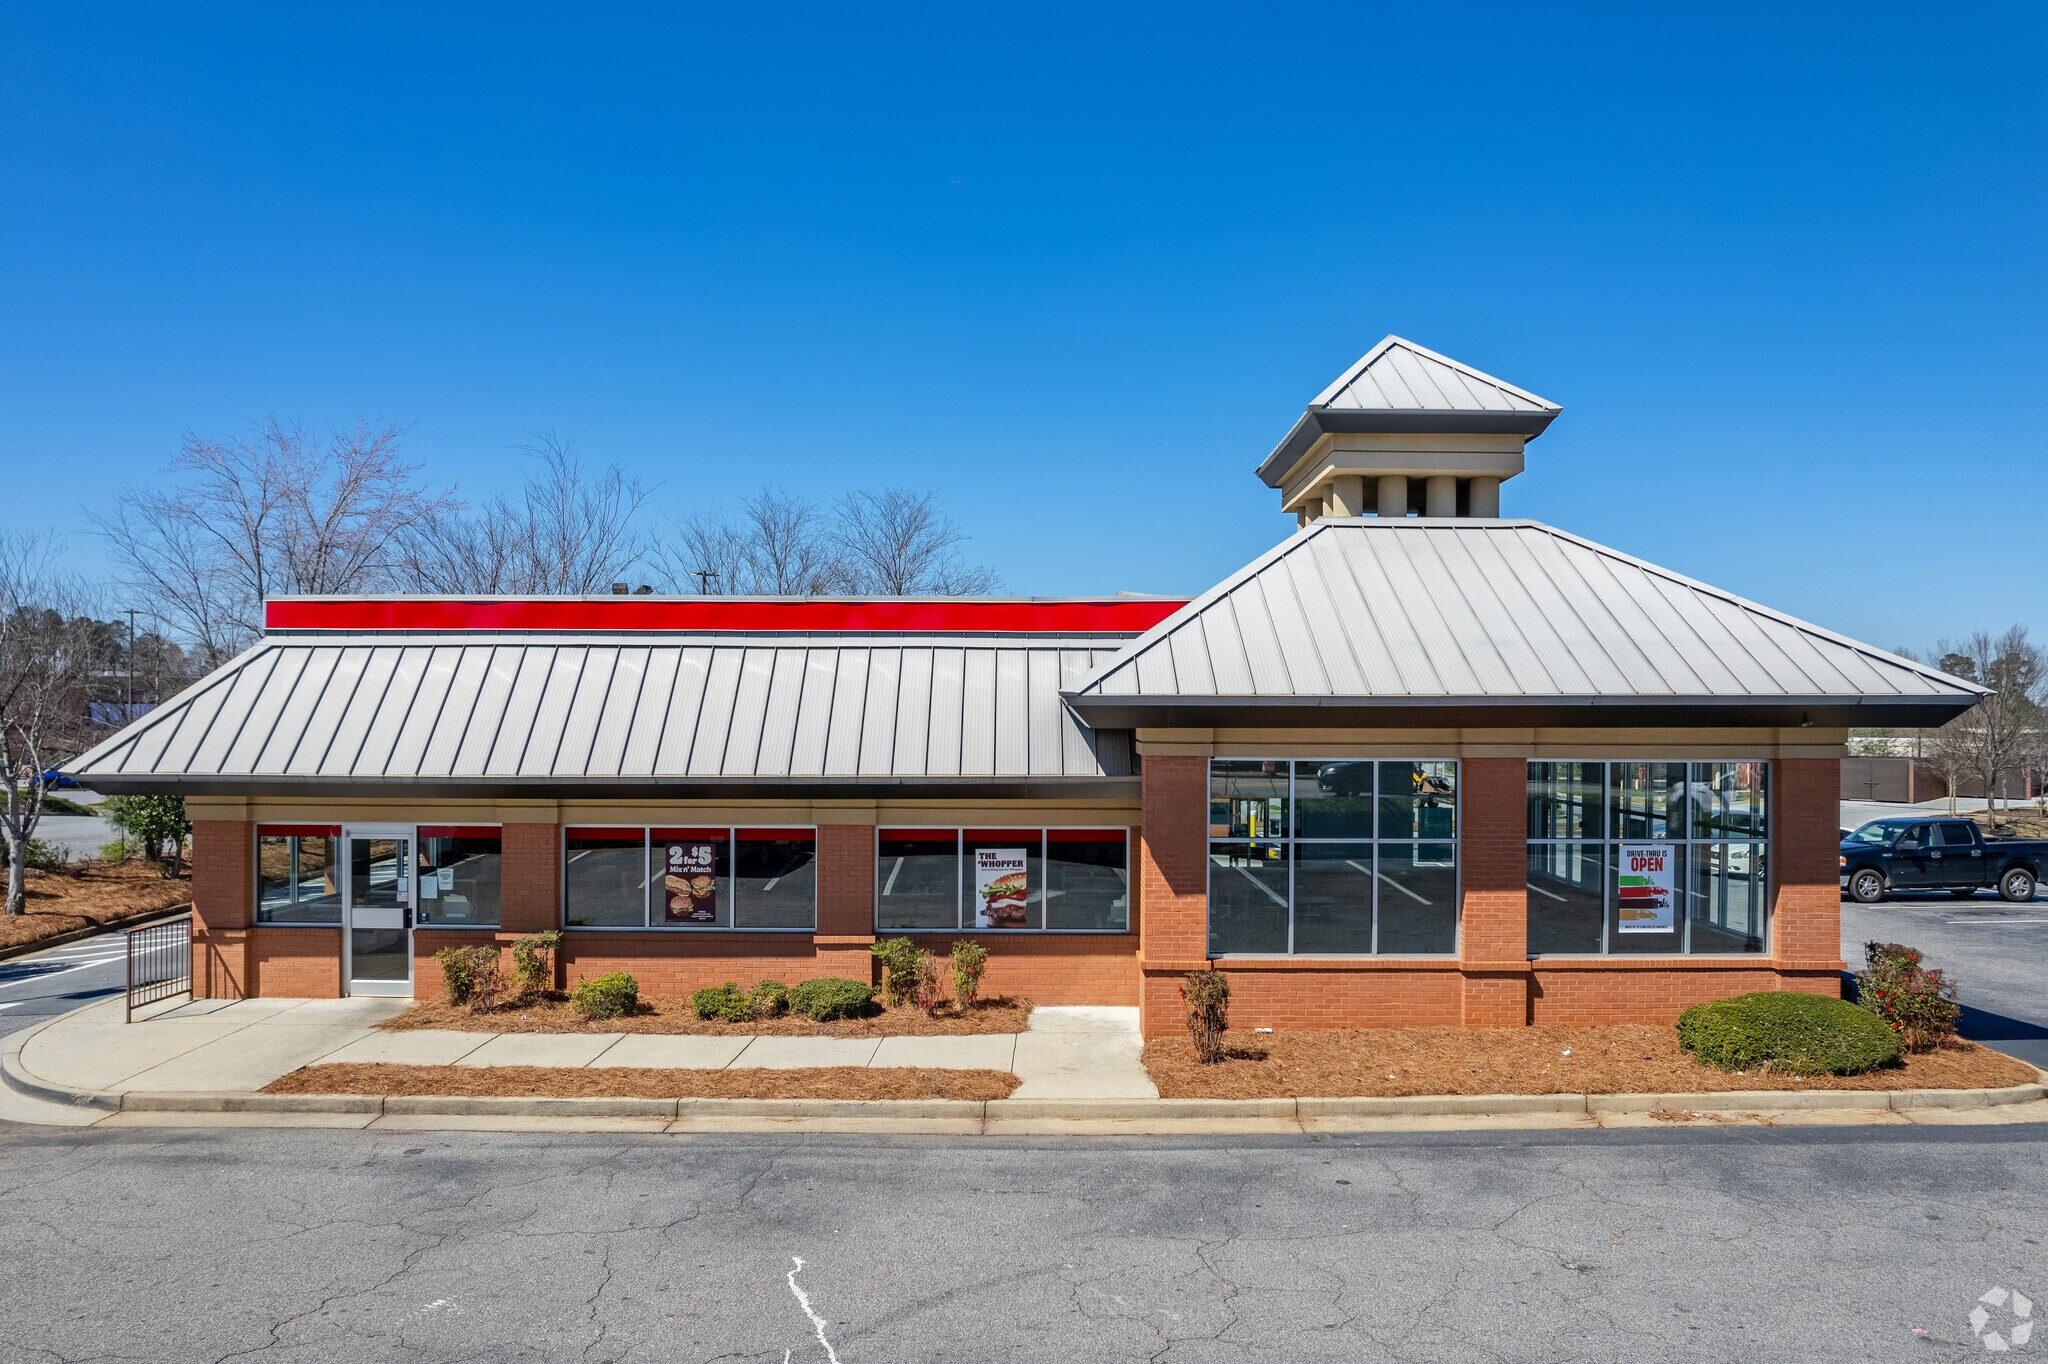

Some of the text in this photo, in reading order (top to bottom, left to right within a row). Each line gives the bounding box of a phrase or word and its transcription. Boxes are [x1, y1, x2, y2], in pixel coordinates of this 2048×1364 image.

[669, 846, 712, 865] 2 for $5
[978, 852, 997, 860] THE
[978, 860, 1024, 868] WHOPPER
[1631, 857, 1663, 871] OPEN
